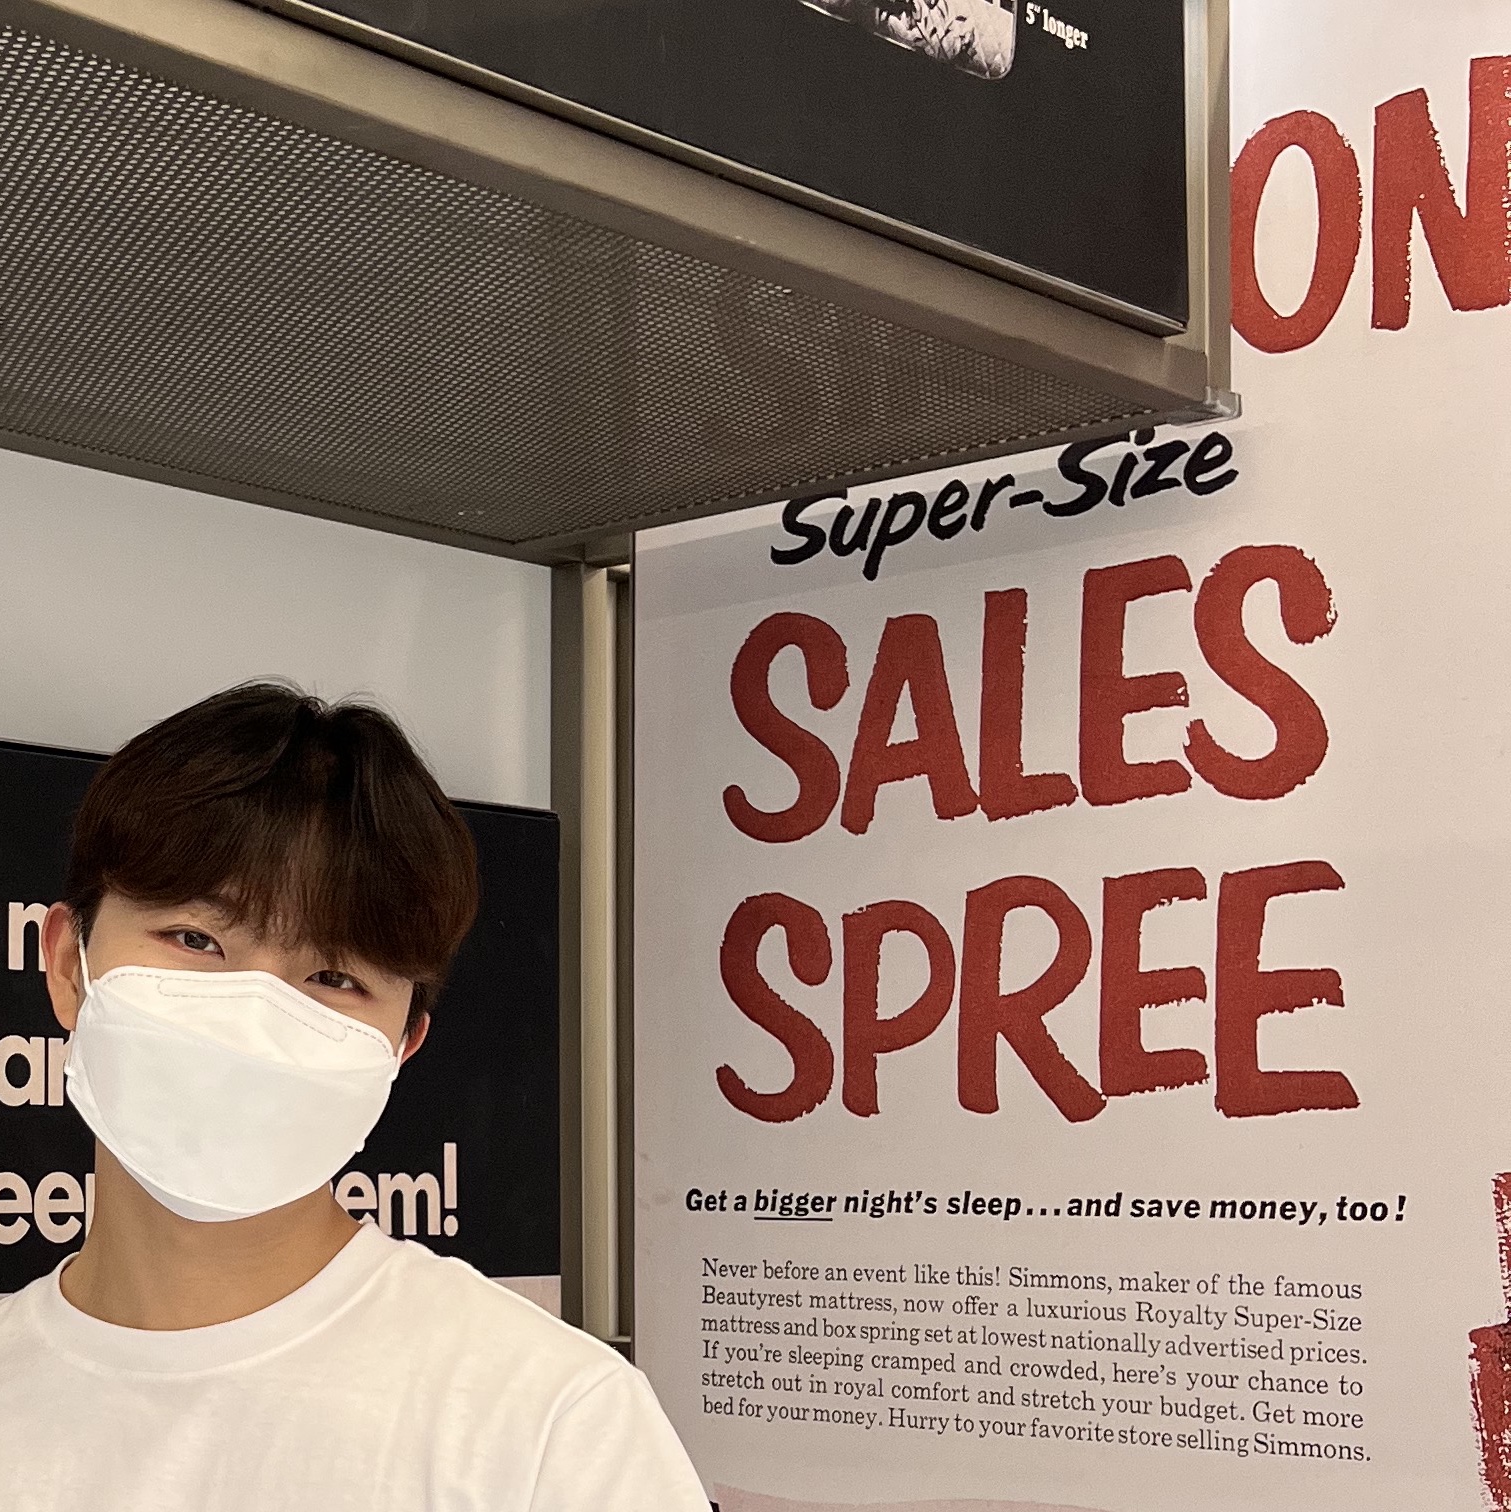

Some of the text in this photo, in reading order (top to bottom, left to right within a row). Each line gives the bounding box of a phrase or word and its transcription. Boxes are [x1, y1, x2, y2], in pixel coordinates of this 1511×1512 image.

[1042, 9, 1088, 50] longer
[771, 425, 1239, 581] Super-Size
[723, 545, 1339, 844] SALES
[716, 860, 1360, 1124] SPREE
[686, 1188, 727, 1213] Get
[734, 1196, 747, 1213] a
[754, 1188, 838, 1218] bigger
[844, 1188, 938, 1218] night's
[1129, 1199, 1201, 1219] save
[1209, 1200, 1328, 1226] money,
[702, 1257, 1362, 1300] Never before an event like this! Simmons, maker of the famous
[701, 1284, 1362, 1333] Beautyrest mattress, now offer a luxurious Royalty Super-Size
[701, 1314, 1367, 1366] mattress and box spring set at lowest nationally advertised prices.
